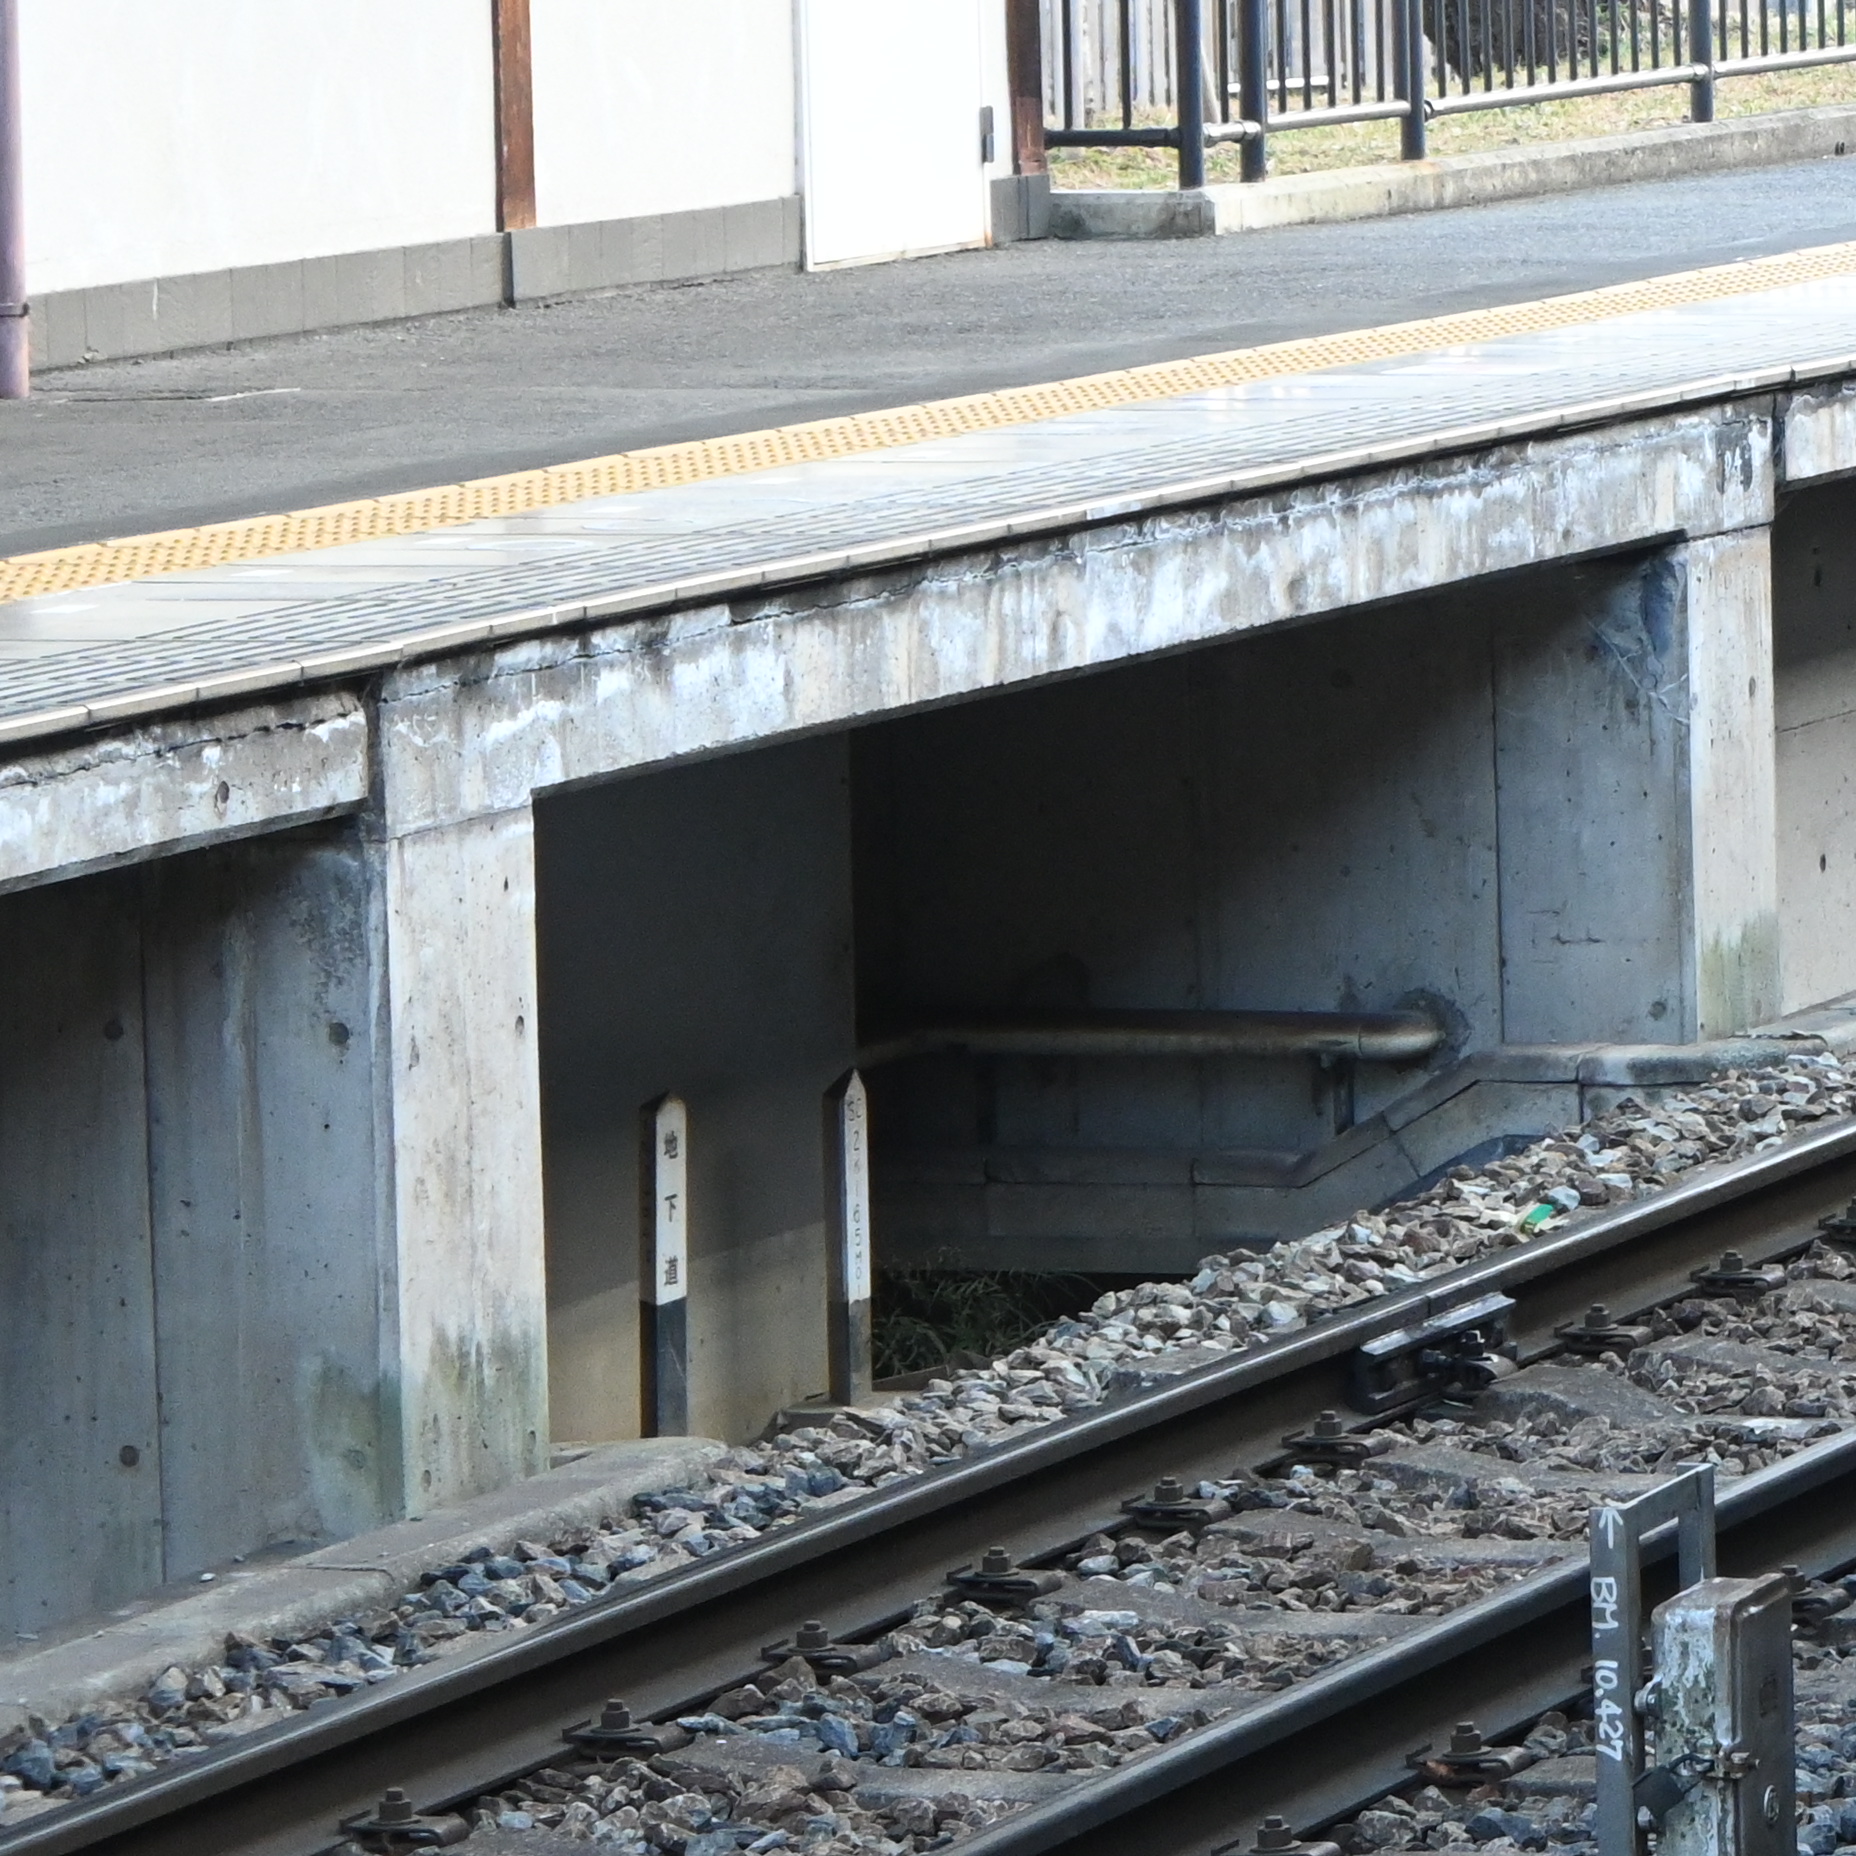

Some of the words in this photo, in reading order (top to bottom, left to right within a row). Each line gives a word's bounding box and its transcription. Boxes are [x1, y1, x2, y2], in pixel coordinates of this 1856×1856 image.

[663, 1129, 679, 1287] 地下道
[1594, 1659, 1624, 1763] 10.427
